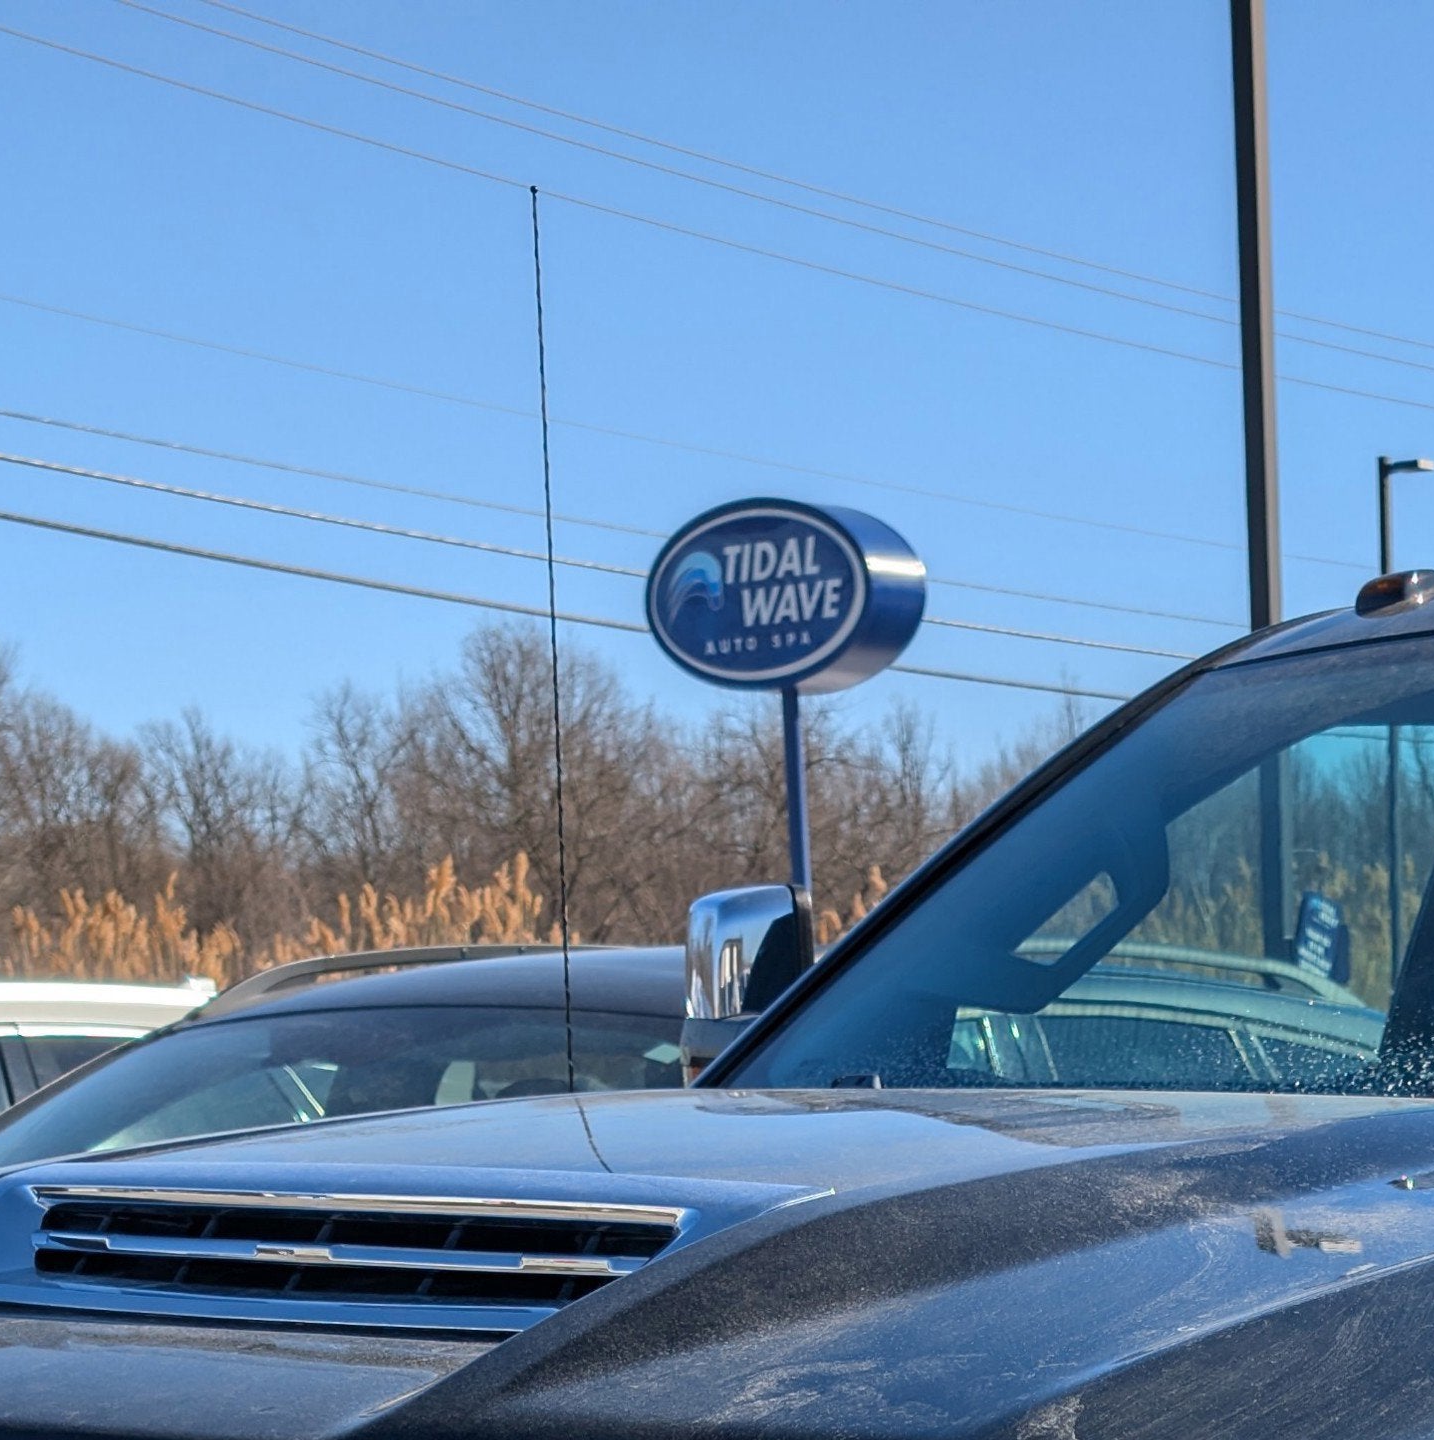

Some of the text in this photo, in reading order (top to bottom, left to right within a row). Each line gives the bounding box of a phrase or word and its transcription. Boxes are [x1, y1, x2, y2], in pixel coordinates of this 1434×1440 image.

[722, 535, 821, 585] TIDAL
[740, 578, 842, 627] WAVE
[704, 631, 812, 655] AUTO SPA
